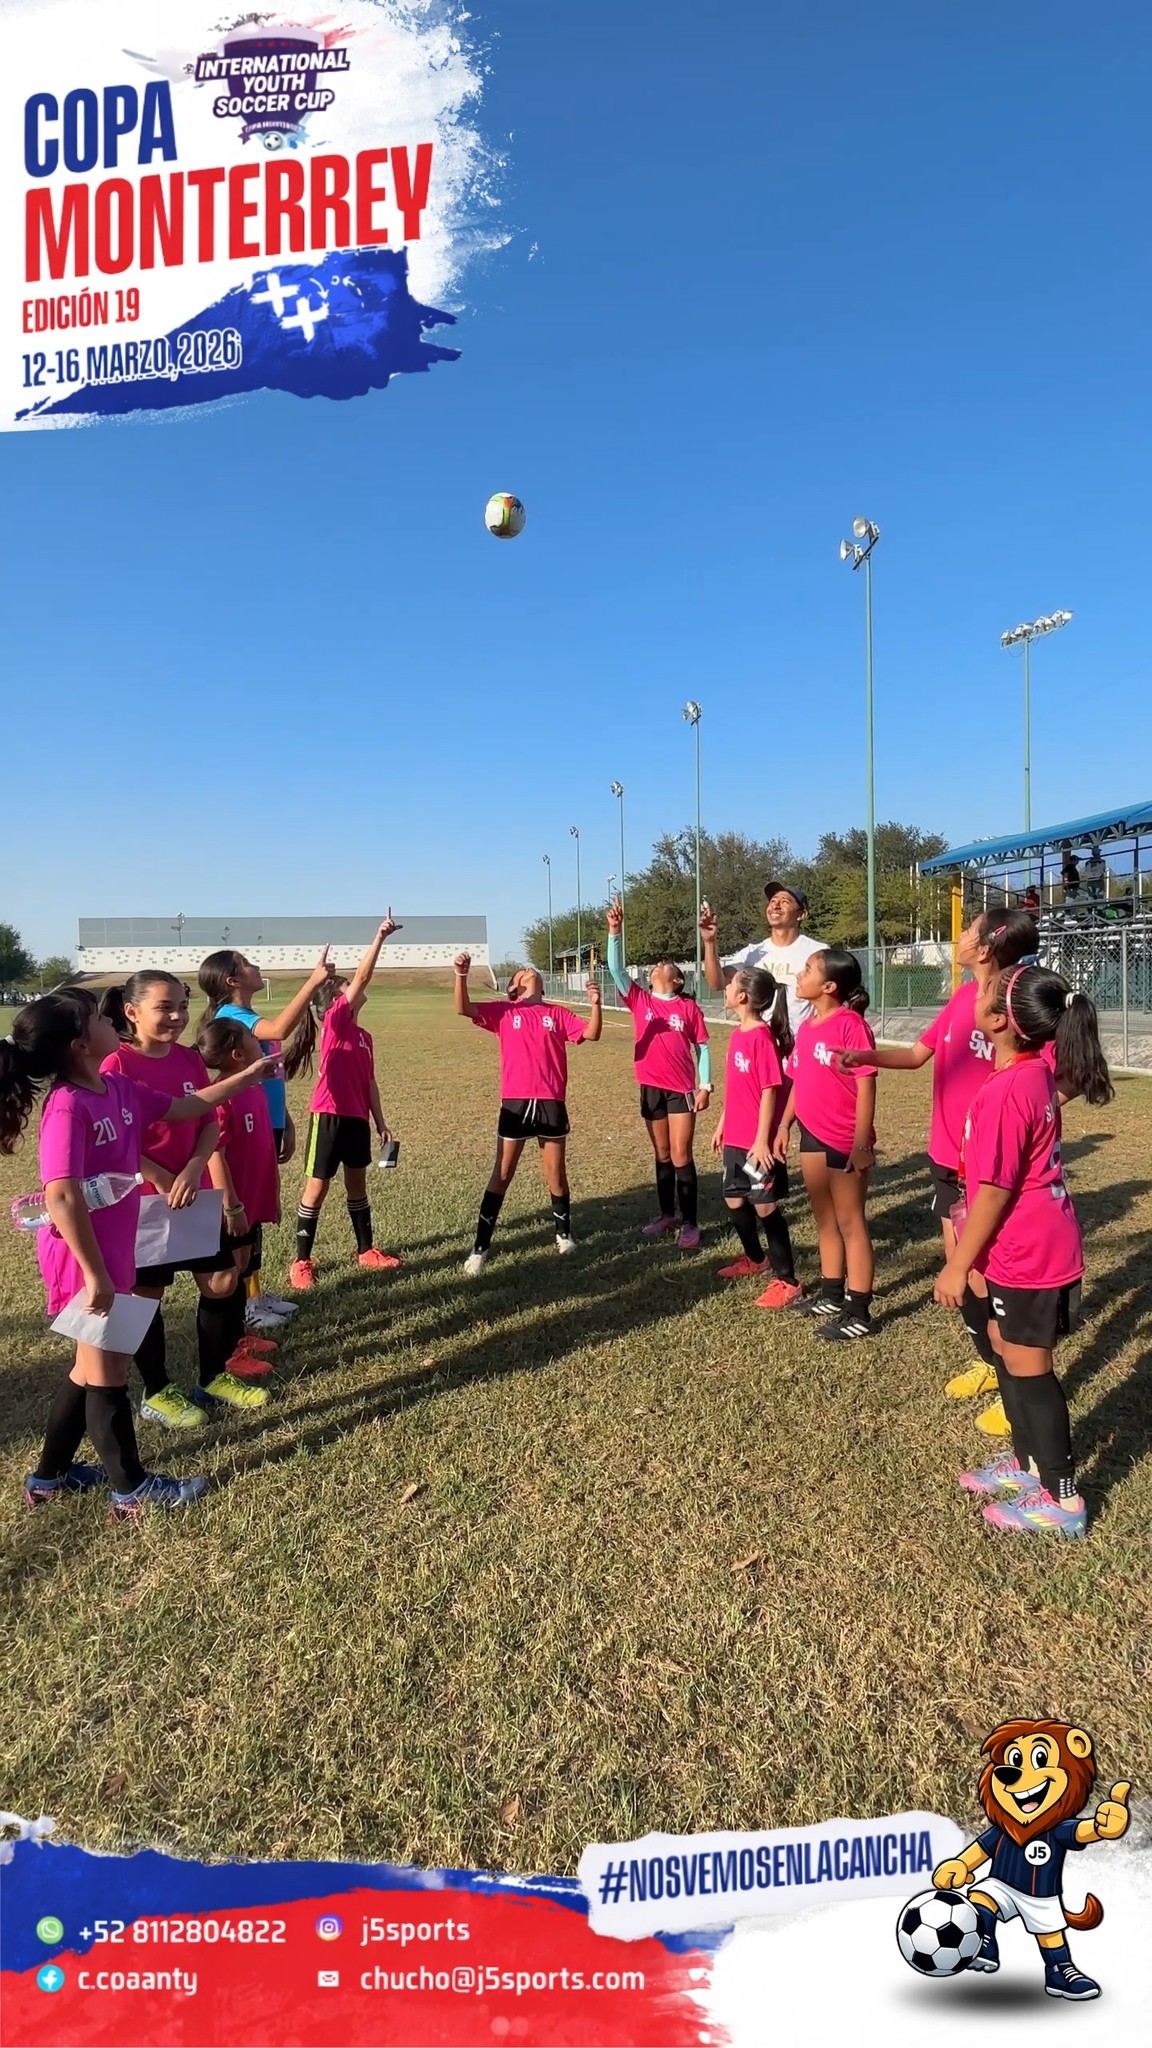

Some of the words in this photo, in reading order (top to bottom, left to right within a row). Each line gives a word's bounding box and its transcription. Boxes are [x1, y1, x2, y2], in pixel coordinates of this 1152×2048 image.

[513, 1015, 521, 1029] 8
[813, 1042, 833, 1066] SN
[969, 1030, 994, 1060] SN
[734, 1051, 750, 1073] SN
[93, 1117, 118, 1146] 20
[244, 1113, 254, 1133] 6
